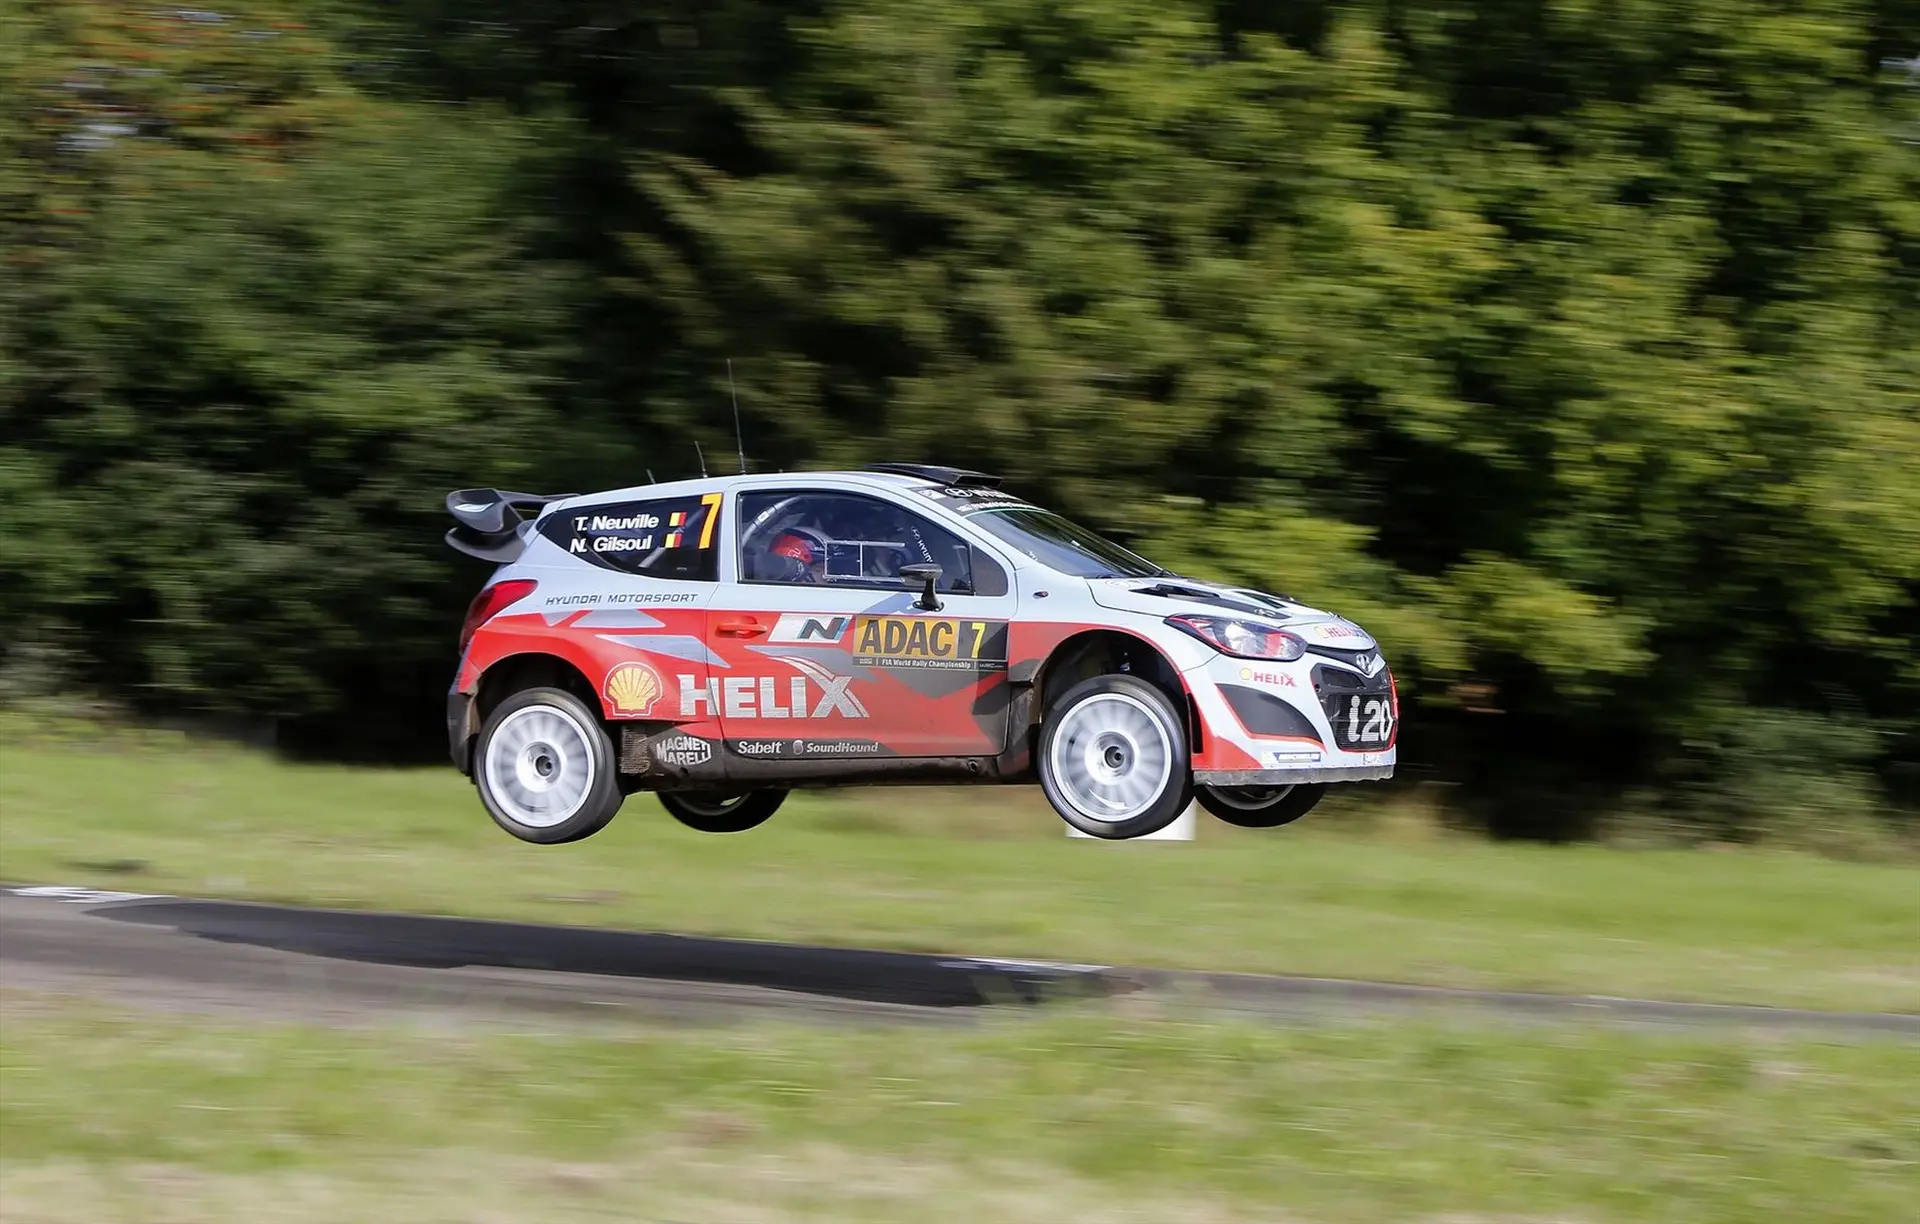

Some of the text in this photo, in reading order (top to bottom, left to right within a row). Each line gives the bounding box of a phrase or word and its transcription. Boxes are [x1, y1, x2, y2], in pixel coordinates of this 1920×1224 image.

[574, 514, 660, 531] T. Neuville
[699, 492, 722, 549] 7
[570, 535, 652, 553] N. Gilsoul
[545, 593, 698, 605] HYUNDAI MOTORSPORT
[859, 619, 953, 656] ADAC
[970, 622, 986, 658] 7
[881, 658, 892, 666] FIA
[893, 659, 911, 667] World
[912, 660, 927, 668] Rally
[928, 660, 971, 669] Championship
[676, 656, 870, 718] HELIX
[1253, 671, 1297, 687] HELIX
[1348, 696, 1393, 742] i20
[737, 741, 782, 754] Sabelt
[806, 742, 878, 754] SoundHound
